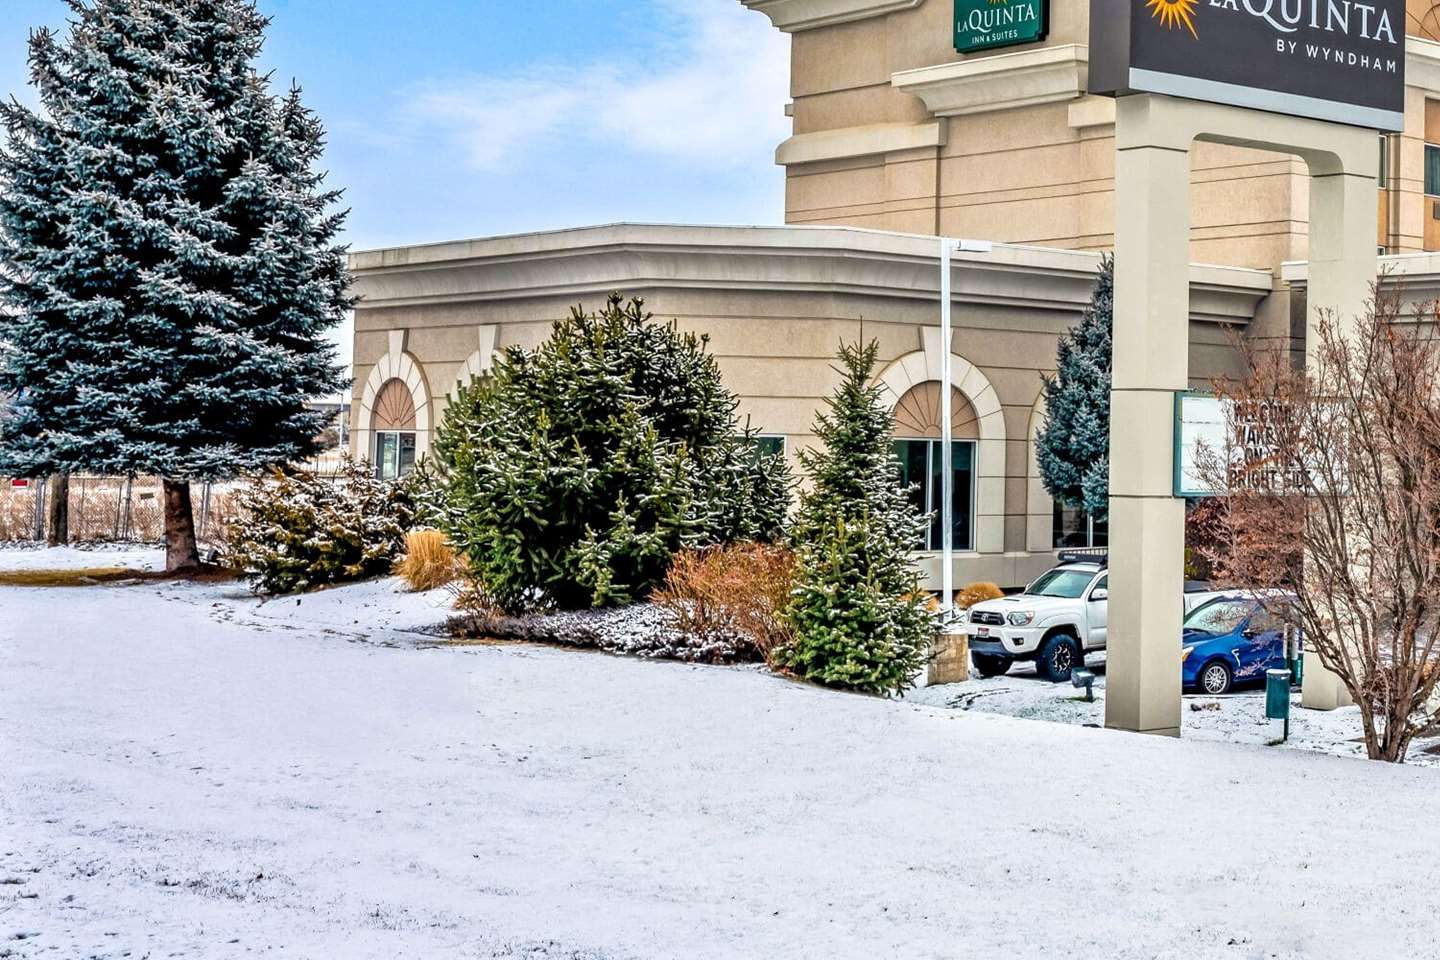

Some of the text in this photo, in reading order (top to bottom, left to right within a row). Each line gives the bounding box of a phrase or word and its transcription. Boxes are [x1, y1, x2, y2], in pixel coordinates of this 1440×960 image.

[957, 2, 1035, 33] LA QUINTA
[971, 34, 985, 44] INN
[991, 29, 1018, 41] SUITES
[1276, 39, 1397, 73] BY WYNDHAM
